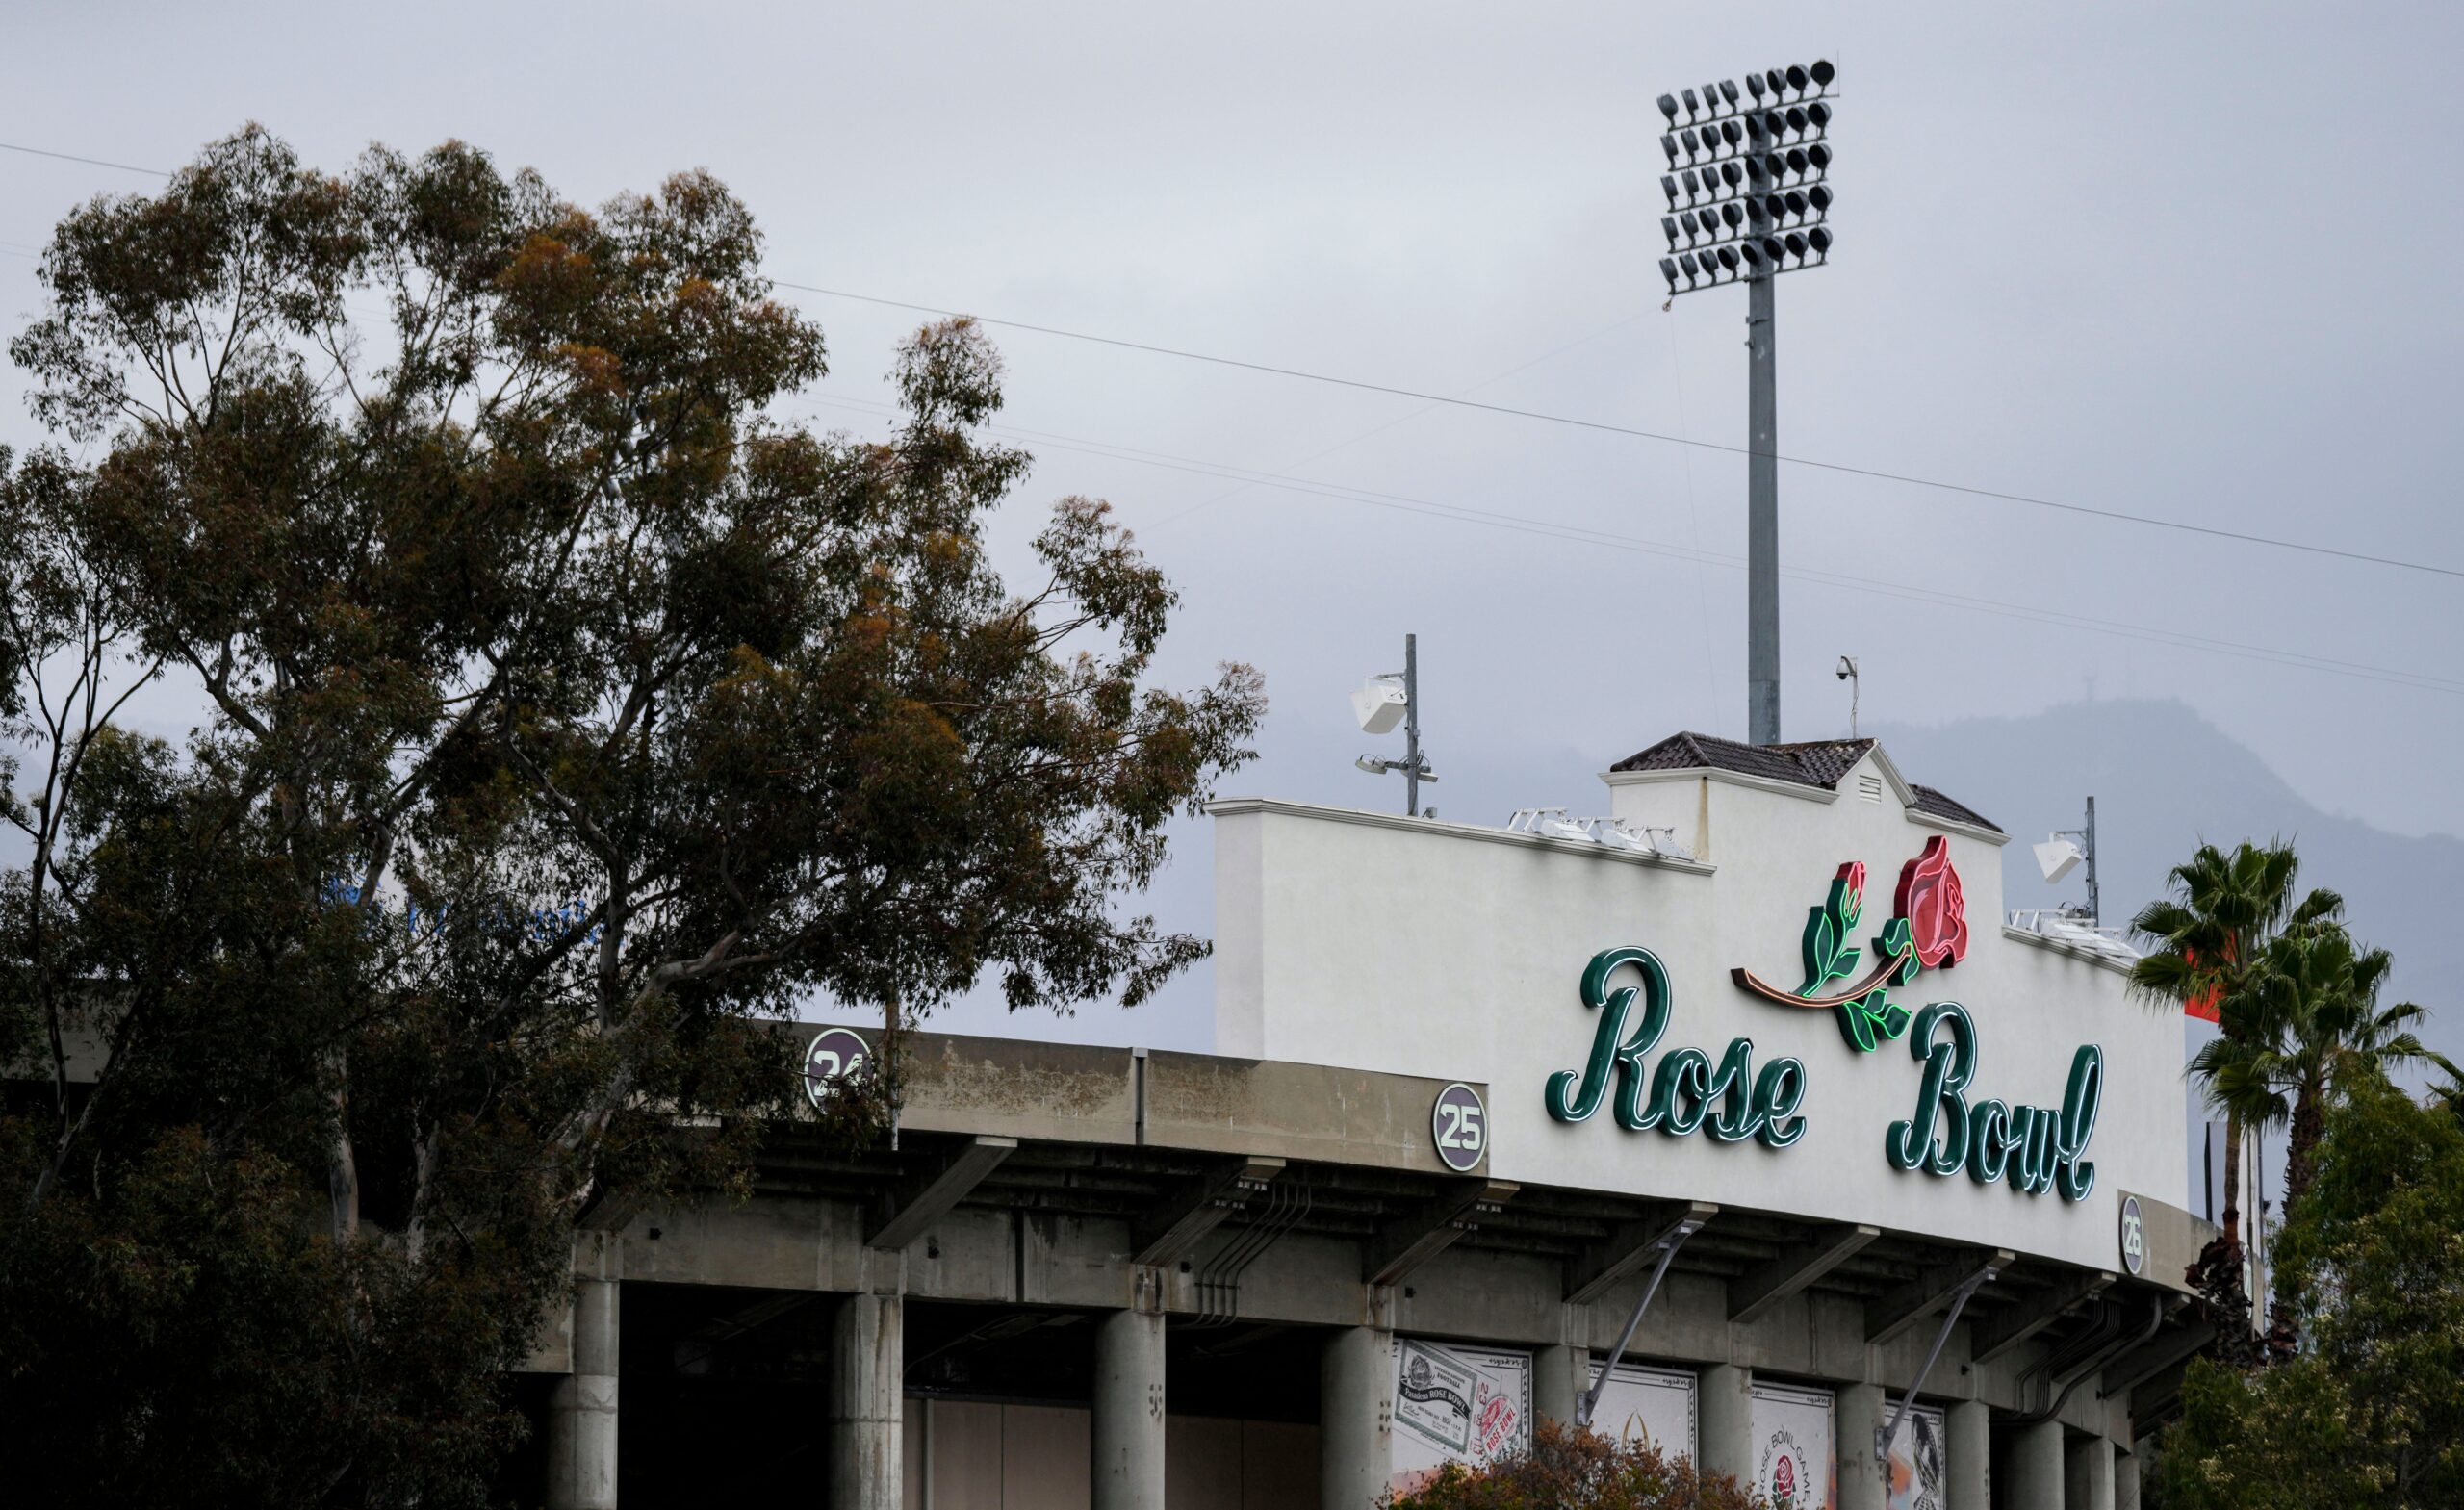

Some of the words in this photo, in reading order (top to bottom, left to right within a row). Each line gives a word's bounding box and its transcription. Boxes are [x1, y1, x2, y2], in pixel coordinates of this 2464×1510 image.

[1545, 945, 1807, 1147] Rose
[1886, 1001, 2104, 1201] Bowl
[1440, 1103, 1481, 1151] 25
[2124, 1215, 2142, 1256] 26
[1404, 1388, 1428, 1400] Pasadena
[1429, 1389, 1447, 1399] ROSE
[1448, 1392, 1466, 1412] BOWL
[1436, 1372, 1461, 1389] FOOTBALL
[1478, 1382, 1489, 1405] 23
[1485, 1427, 1502, 1452] ROSE
[1499, 1407, 1517, 1431] BOWL
[1758, 1445, 1771, 1497] ROSE
[1771, 1424, 1795, 1451] BOWL
[1796, 1446, 1810, 1502] GAME
